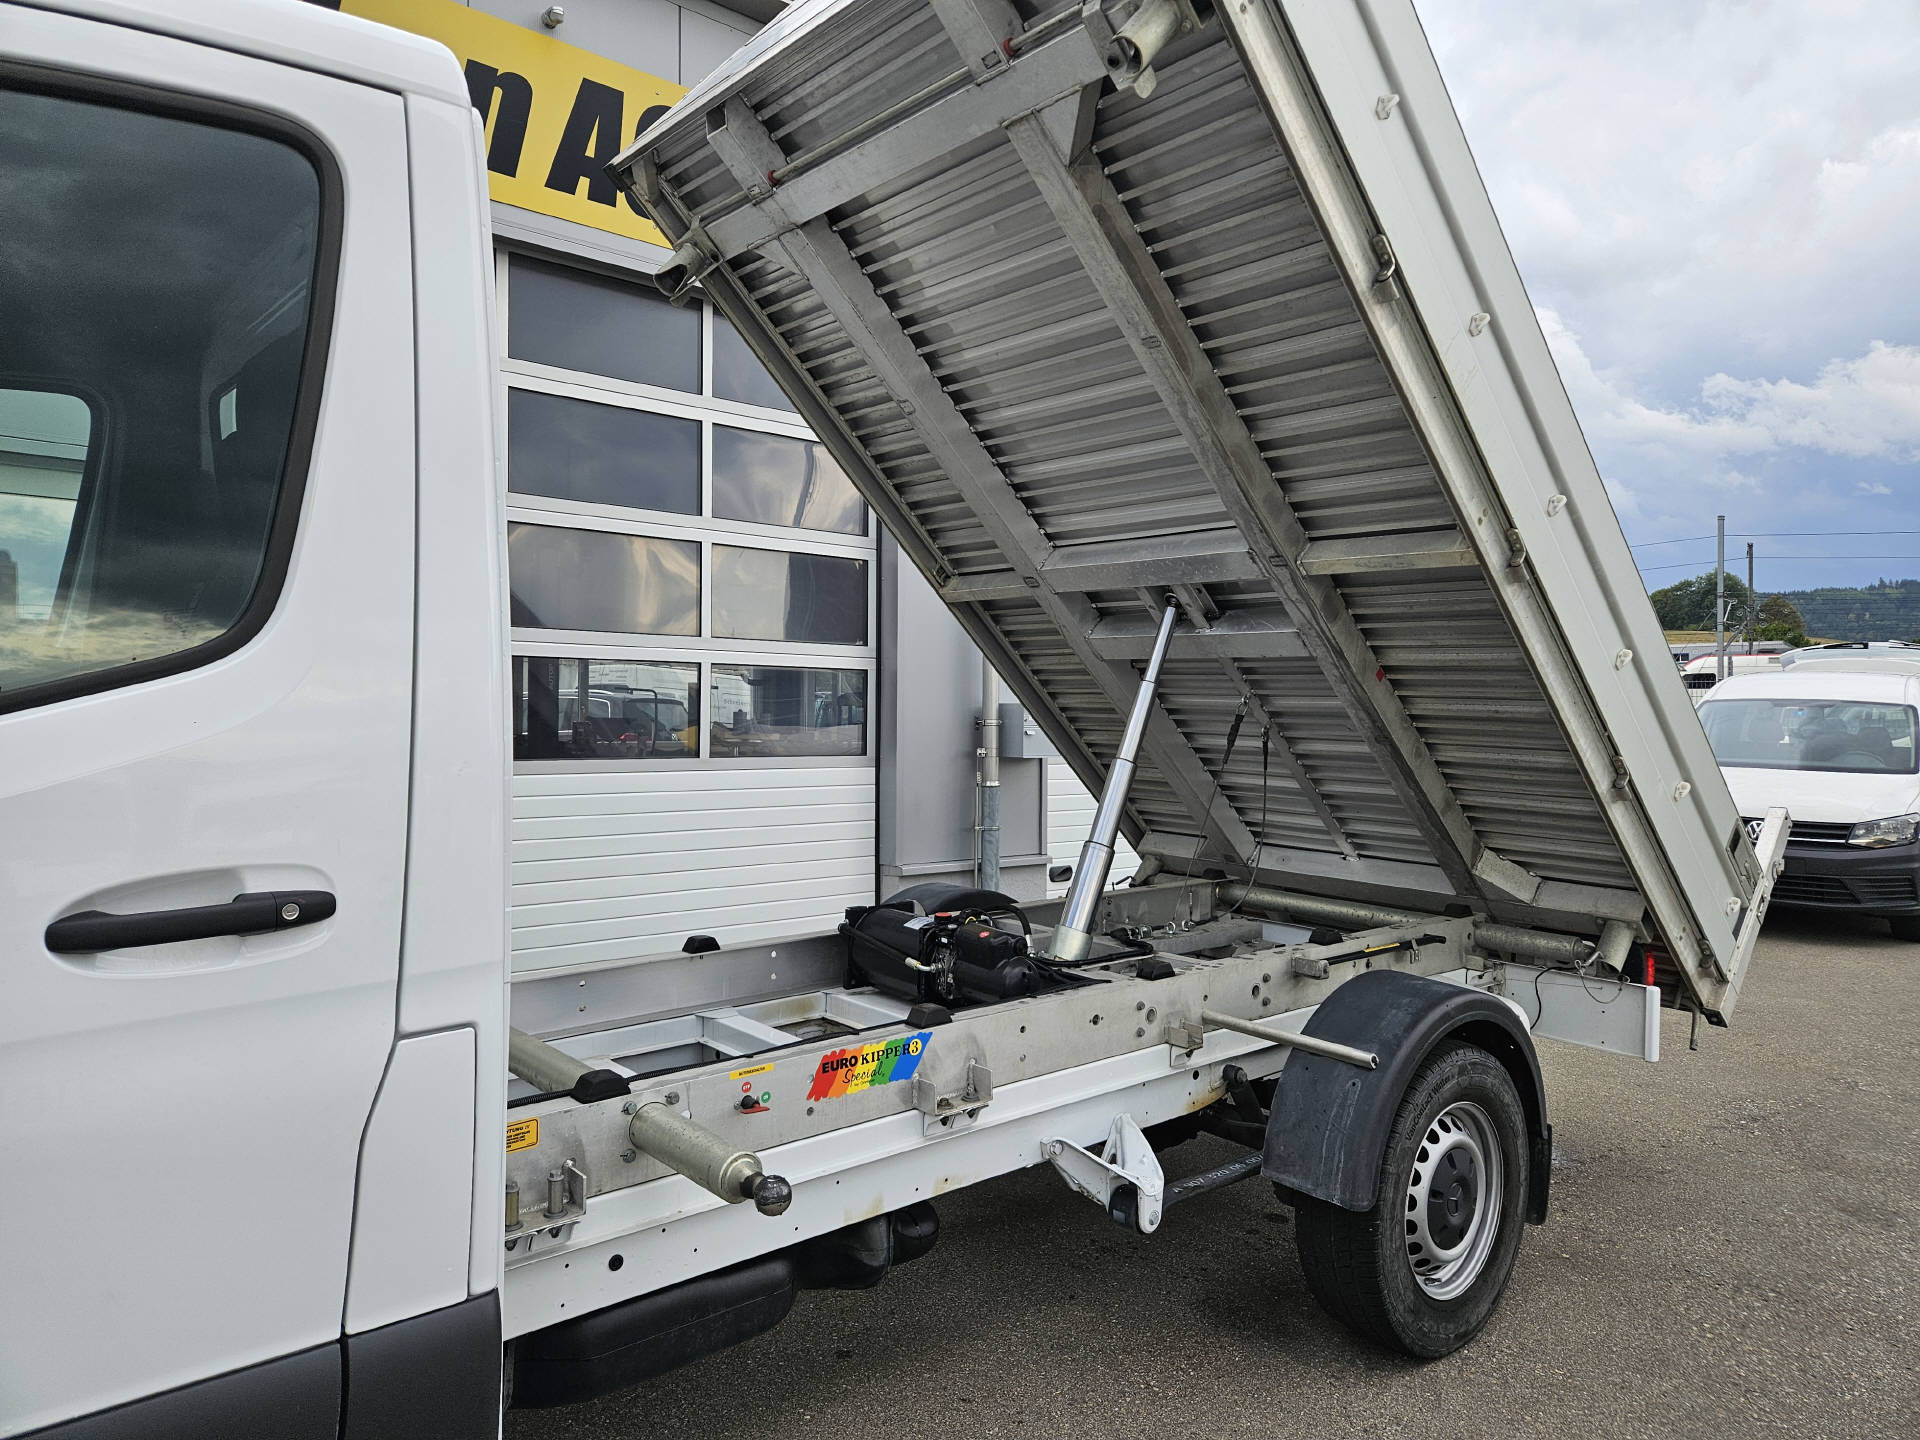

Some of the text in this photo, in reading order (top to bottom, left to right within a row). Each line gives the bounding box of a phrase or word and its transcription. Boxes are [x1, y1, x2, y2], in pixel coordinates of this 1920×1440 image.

[821, 1040, 919, 1075] EURO KIPPER 3
[842, 1060, 884, 1088] Special
